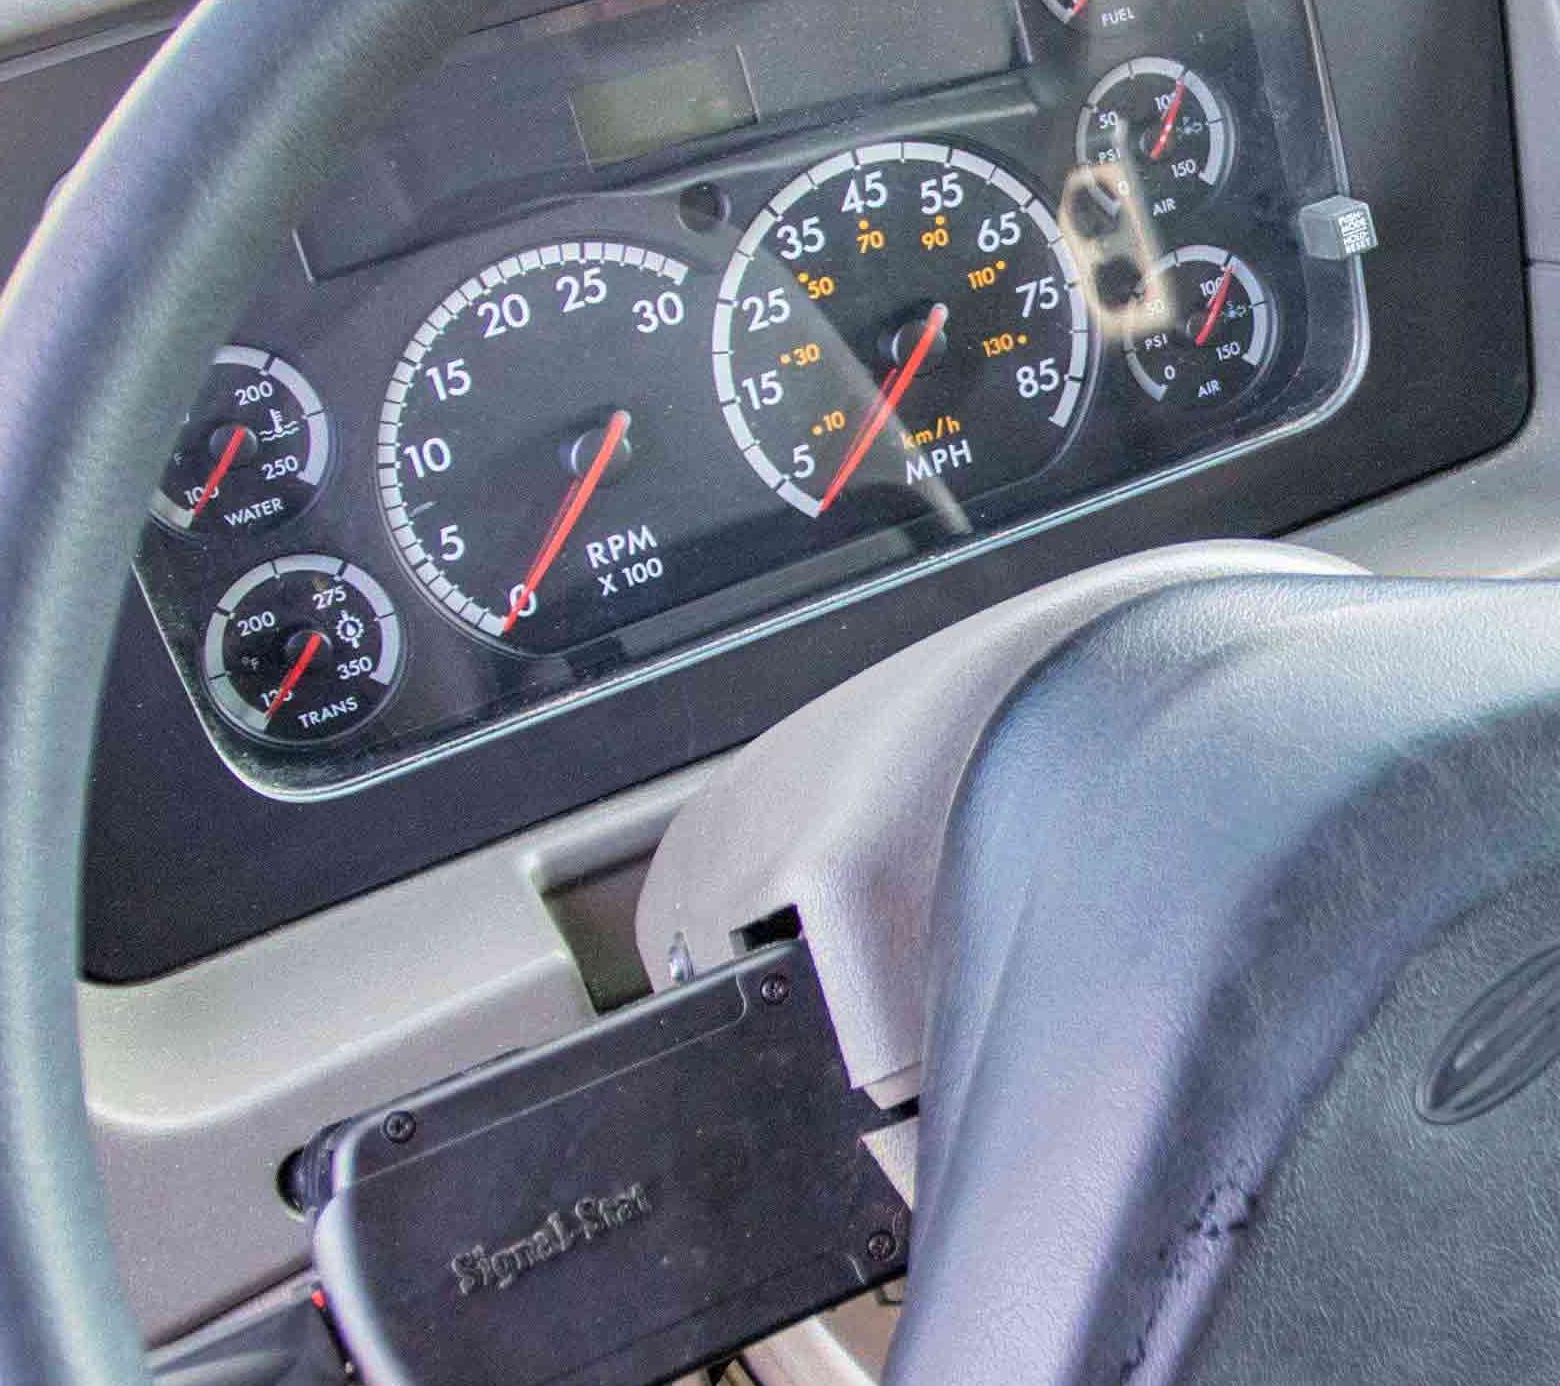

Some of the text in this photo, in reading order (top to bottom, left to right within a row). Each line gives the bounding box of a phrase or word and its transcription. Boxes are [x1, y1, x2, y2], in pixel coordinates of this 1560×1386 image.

[1101, 7, 1136, 27] FUEL
[1098, 112, 1119, 130] 50
[1171, 159, 1197, 179] 150
[841, 170, 888, 213] 45
[920, 173, 964, 214] 55
[1152, 197, 1176, 216] AIR
[776, 216, 825, 260] 35
[856, 230, 885, 254] 70
[921, 228, 950, 250] 90
[977, 211, 1021, 253] 65
[555, 274, 607, 312] 25
[807, 276, 836, 300] 50
[967, 267, 996, 290] 110
[632, 291, 684, 333] 30
[742, 287, 791, 332] 25
[1015, 276, 1060, 318] 75
[476, 292, 531, 337] 20
[794, 343, 821, 366] 30
[983, 333, 1015, 358] 130
[1144, 333, 1168, 350] PSI
[1215, 341, 1241, 362] 150
[426, 359, 472, 401] 15
[1015, 358, 1060, 398] 85
[1163, 365, 1176, 380] 0
[235, 381, 274, 406] 200
[741, 369, 784, 411] 15
[1197, 379, 1221, 398] AIR
[824, 410, 847, 433] 10
[902, 415, 961, 450] km/h
[261, 455, 299, 481] 250
[404, 438, 452, 479] 10
[792, 444, 816, 479] 5
[905, 439, 973, 485] MPH
[224, 497, 285, 527] WATER
[439, 527, 465, 561] 5
[586, 524, 658, 570] RPM
[598, 558, 665, 597] X 100
[312, 584, 348, 611] 275
[237, 610, 276, 638] 200
[336, 655, 373, 681] 350
[298, 696, 359, 729] TRANS
